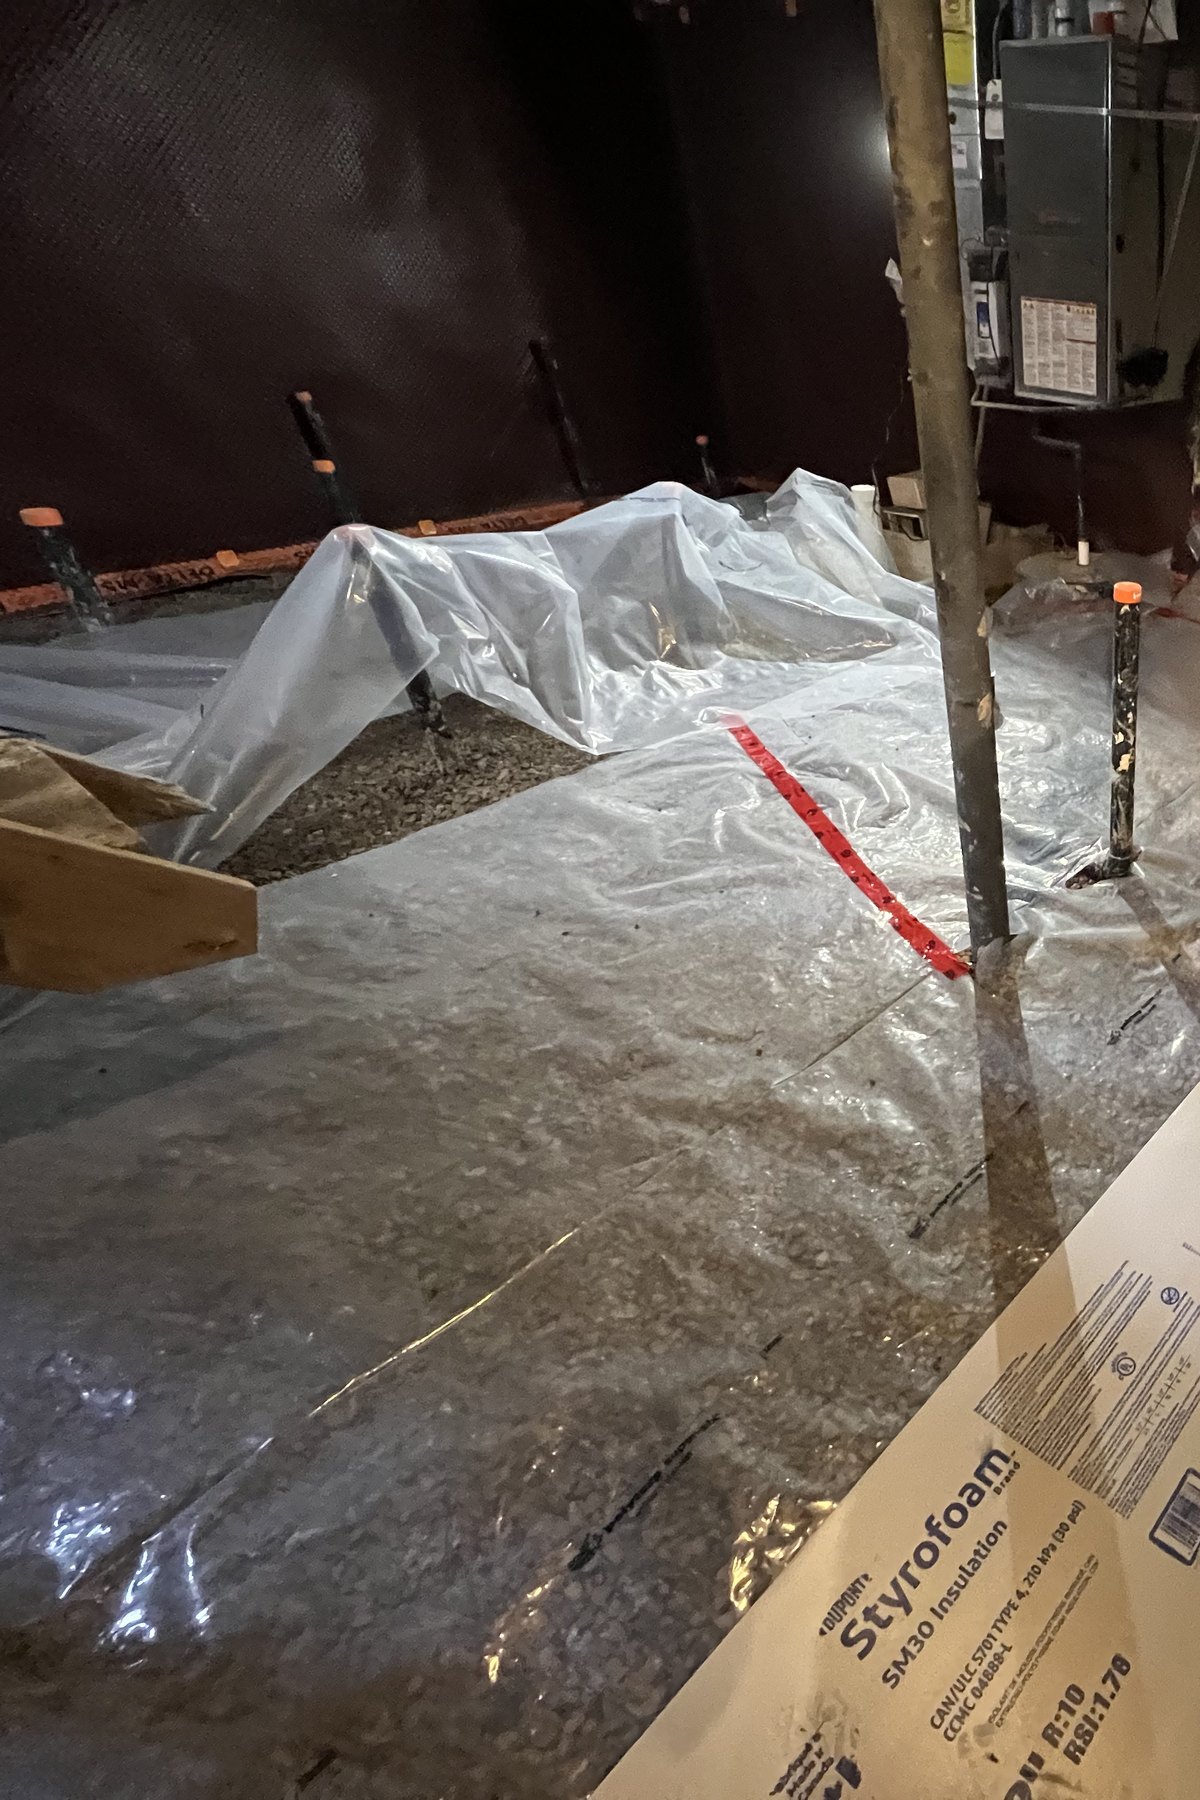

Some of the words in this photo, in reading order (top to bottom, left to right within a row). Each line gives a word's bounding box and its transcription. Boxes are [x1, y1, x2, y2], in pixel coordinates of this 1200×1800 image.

[993, 1461, 1021, 1496] Brand
[1067, 1499, 1087, 1525] psi)
[1052, 1521, 1070, 1544] (30
[840, 1448, 1011, 1661] Styrofoam
[1036, 1542, 1058, 1566] kPa
[1015, 1588, 1030, 1602] 4,
[1022, 1564, 1042, 1589] 210
[881, 1619, 935, 1690] SM30
[929, 1520, 1008, 1621] Insulation
[991, 1598, 1020, 1634] TYPE
[971, 1626, 999, 1668] S701
[930, 1662, 978, 1730] CAN/ULC
[943, 1697, 976, 1742] CCMC
[970, 1643, 1014, 1701] 04888-L
[1062, 1653, 1131, 1766] RSI:1.78
[1041, 1683, 1086, 1749] R:10
